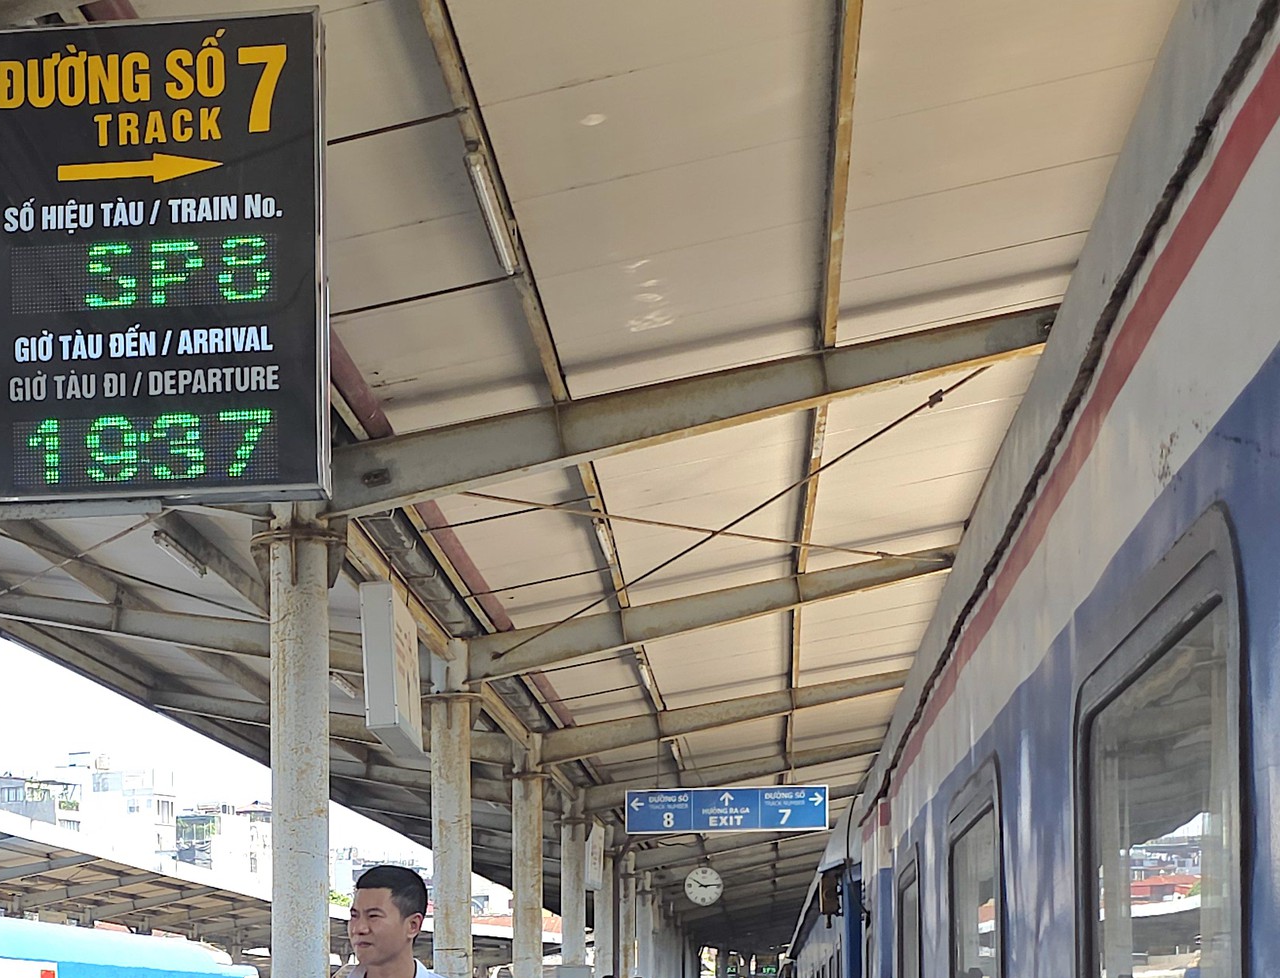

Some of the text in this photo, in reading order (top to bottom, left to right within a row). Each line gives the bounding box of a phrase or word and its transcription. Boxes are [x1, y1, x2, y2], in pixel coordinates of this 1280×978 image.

[164, 28, 227, 101] SỐ
[237, 44, 288, 134] 7
[93, 106, 223, 147] TRACK
[3, 198, 36, 233] SỐ
[41, 200, 94, 235] HIỆU
[100, 198, 147, 228] TÀU
[168, 195, 239, 224] TRAIN
[243, 193, 284, 220] No.
[83, 234, 273, 308] SP8
[13, 330, 54, 363] GIỜ
[58, 329, 104, 360] TÀU
[108, 323, 158, 358] ĐẾN
[177, 325, 274, 354] ARRIVAL
[8, 371, 47, 403] GIỜ
[55, 369, 98, 400] TÀU
[102, 370, 128, 399] ĐI
[147, 364, 281, 396] DEPARTURE
[662, 812, 675, 828] 8
[708, 815, 744, 827] EXIT
[778, 808, 792, 825] 7
